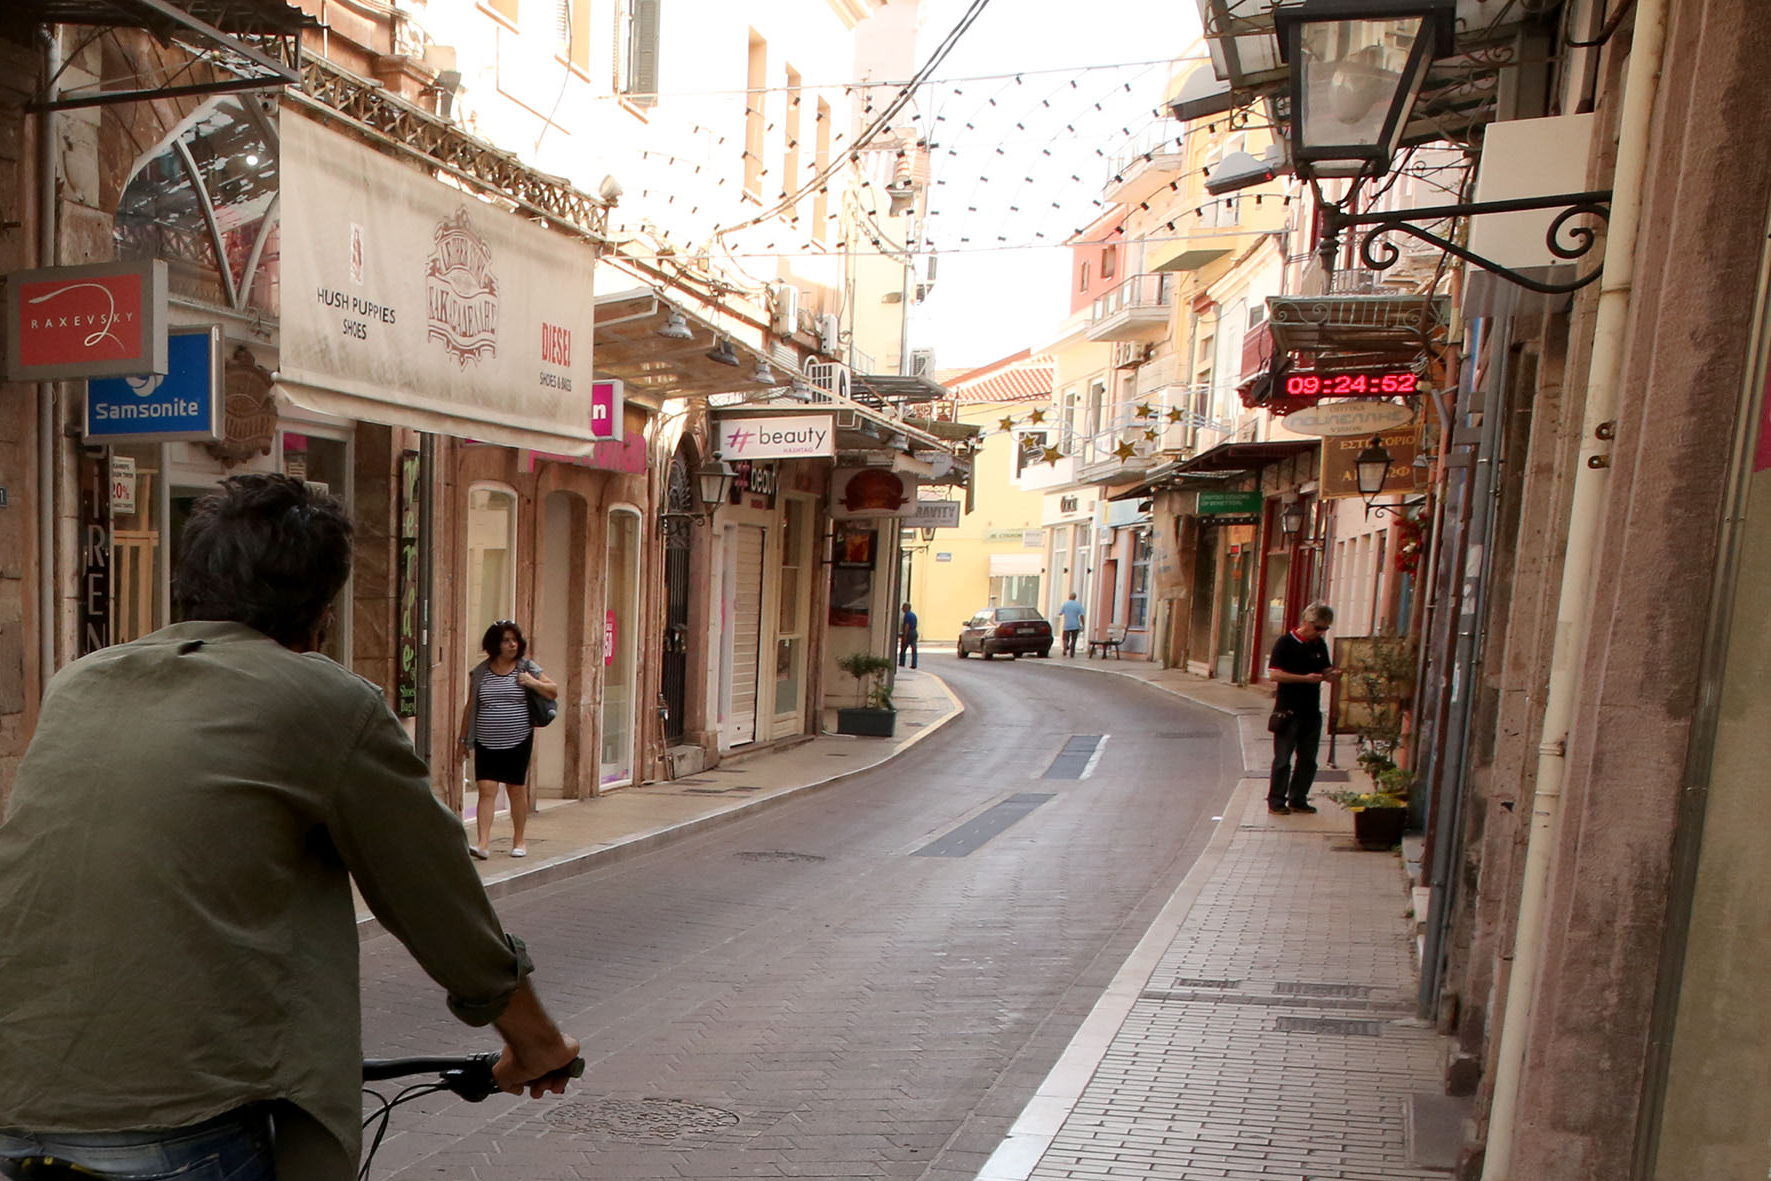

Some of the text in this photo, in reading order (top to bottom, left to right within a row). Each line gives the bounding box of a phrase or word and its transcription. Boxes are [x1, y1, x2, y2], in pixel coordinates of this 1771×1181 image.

[317, 287, 396, 324] HUSH PUPPIES
[30, 311, 134, 329] RAXEVSKY
[343, 318, 367, 340] SHOES
[541, 321, 571, 368] DIESEL
[539, 371, 556, 388] SHOES
[1286, 373, 1416, 395] 09:24:52
[95, 397, 199, 420] Samsonite
[759, 425, 827, 450] beauty
[1340, 435, 1416, 450] ΕΣΤΙΤΟΡΙΟ
